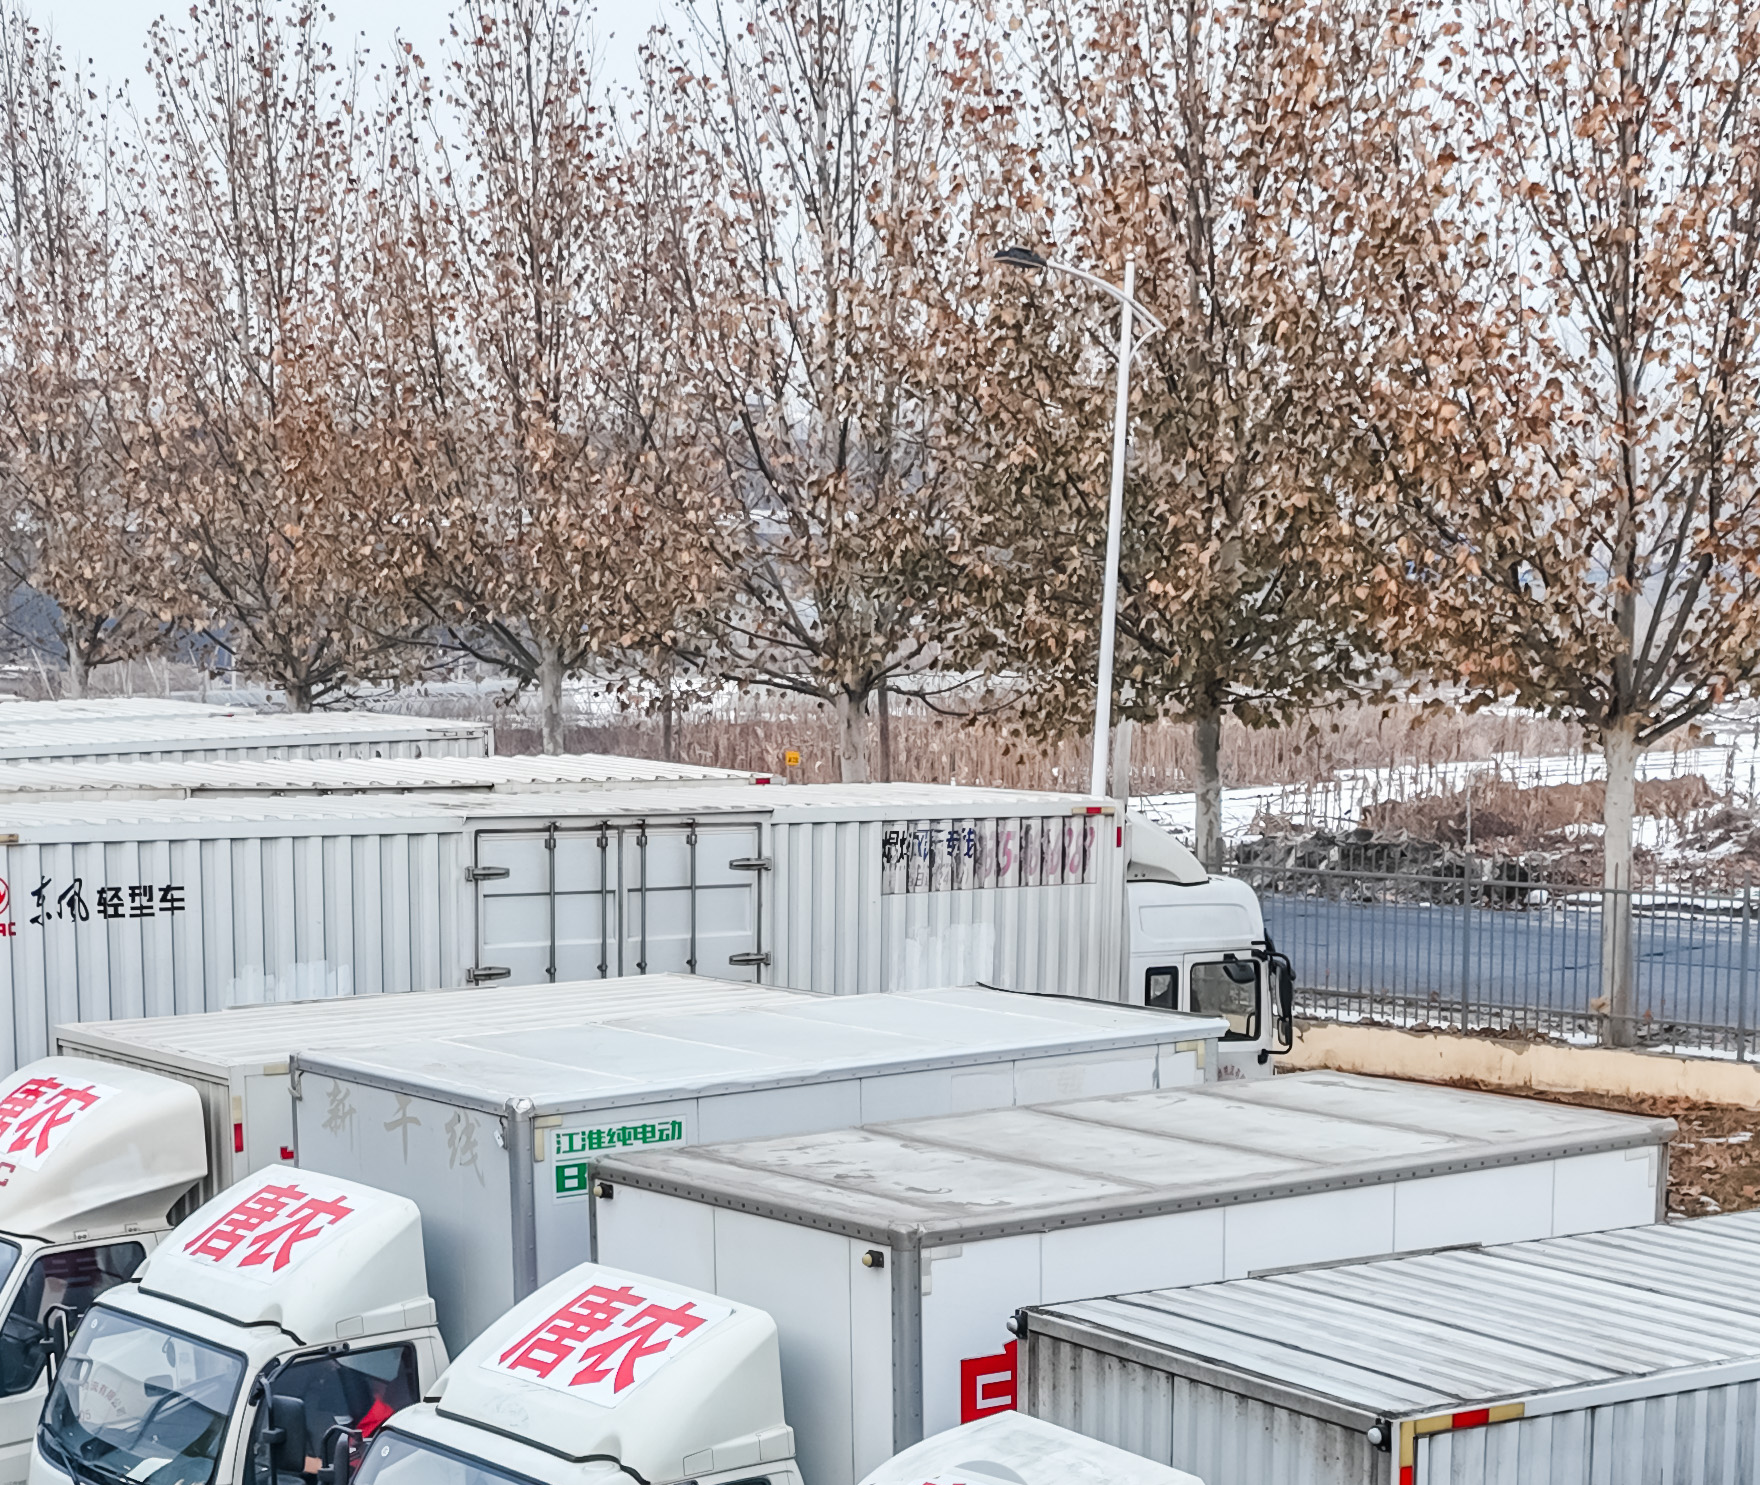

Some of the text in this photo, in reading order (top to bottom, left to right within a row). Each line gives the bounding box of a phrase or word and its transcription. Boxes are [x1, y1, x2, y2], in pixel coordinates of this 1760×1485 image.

[30, 876, 186, 926] 东风轻型车
[556, 1120, 683, 1155] 江淮纯电动
[186, 1184, 355, 1273] 唐农
[499, 1285, 709, 1394] 唐农
